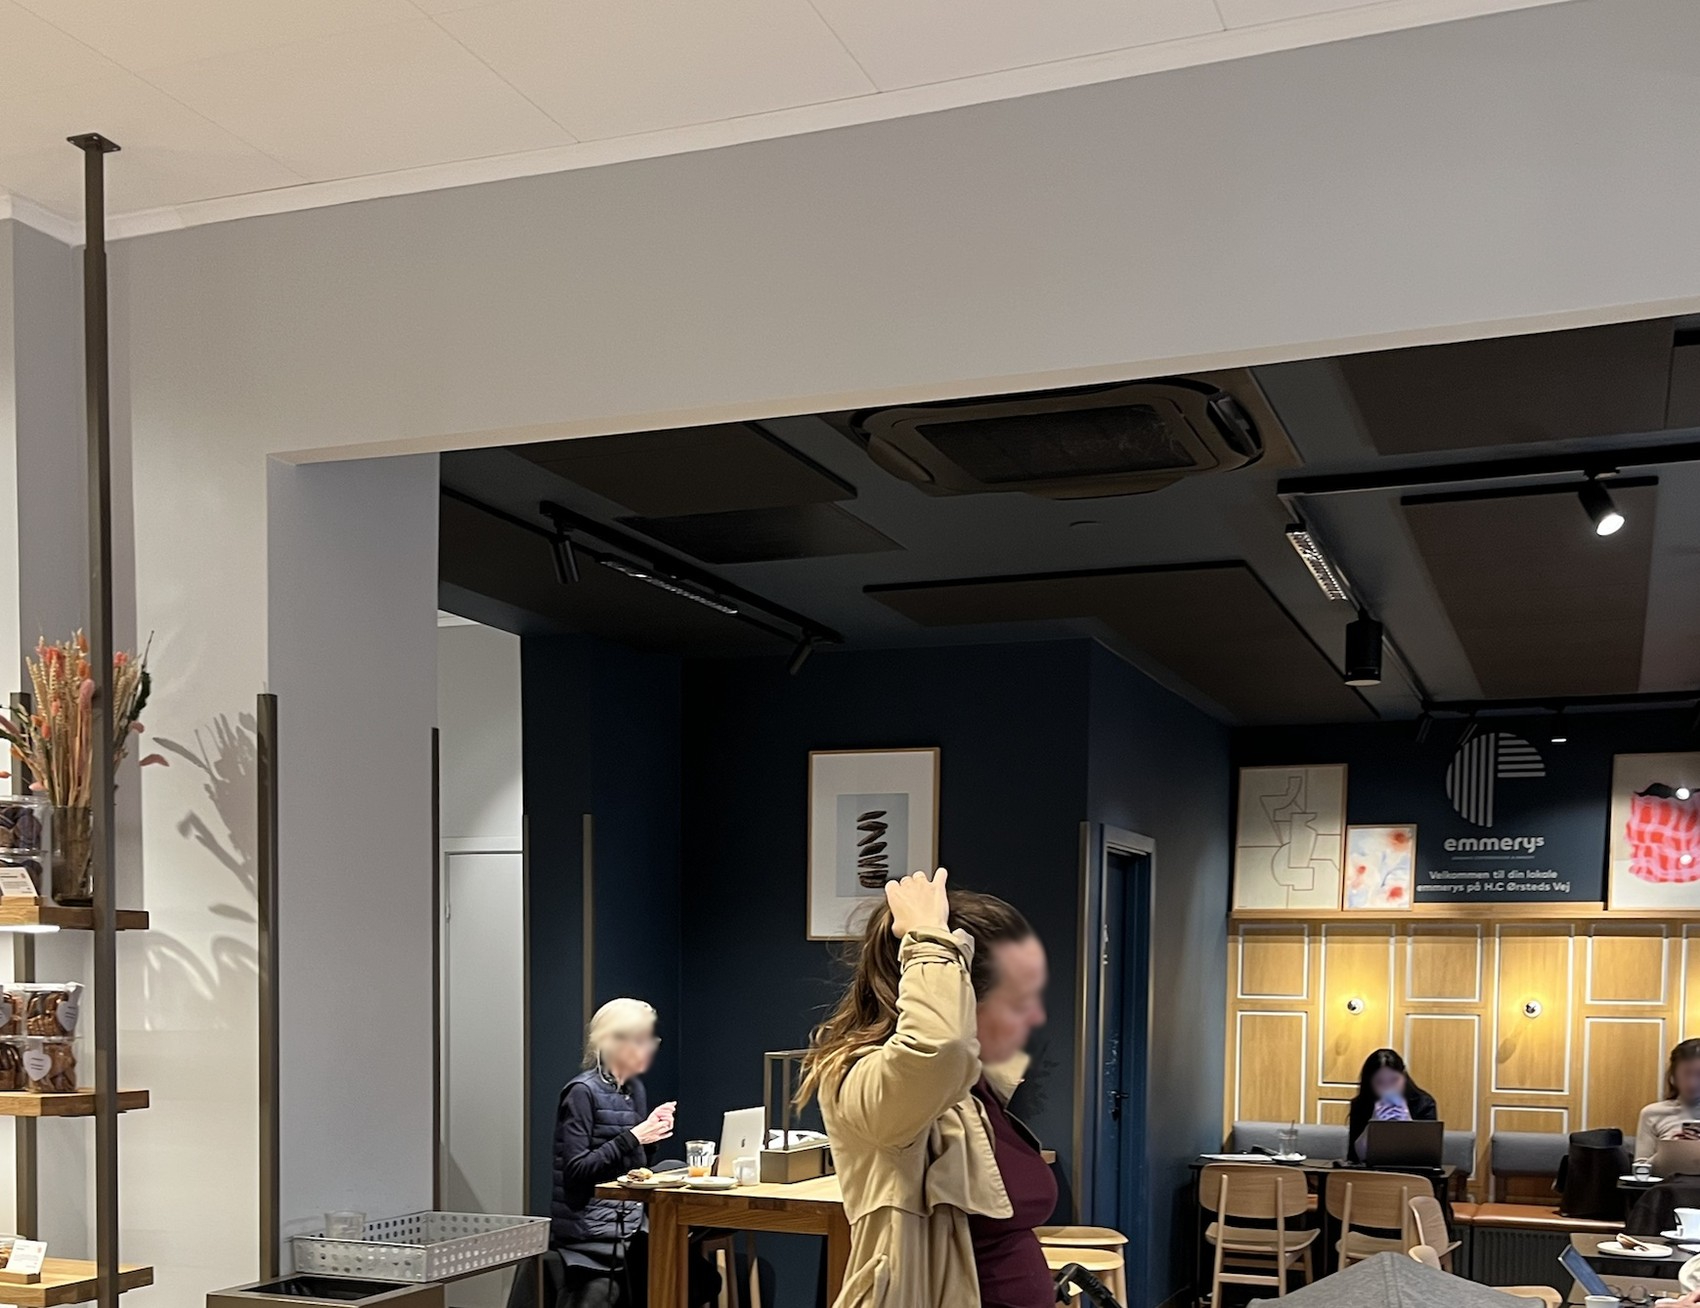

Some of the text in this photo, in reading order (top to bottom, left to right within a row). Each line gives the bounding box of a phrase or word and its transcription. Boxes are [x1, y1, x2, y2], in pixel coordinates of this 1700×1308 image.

[1443, 836, 1545, 853] emmerys
[1428, 869, 1558, 880] Velkommen til din lokale
[1416, 884, 1465, 894] emmerys
[1466, 881, 1481, 893] på
[1506, 881, 1551, 892] Ørsteds
[1552, 881, 1571, 893] Vej
